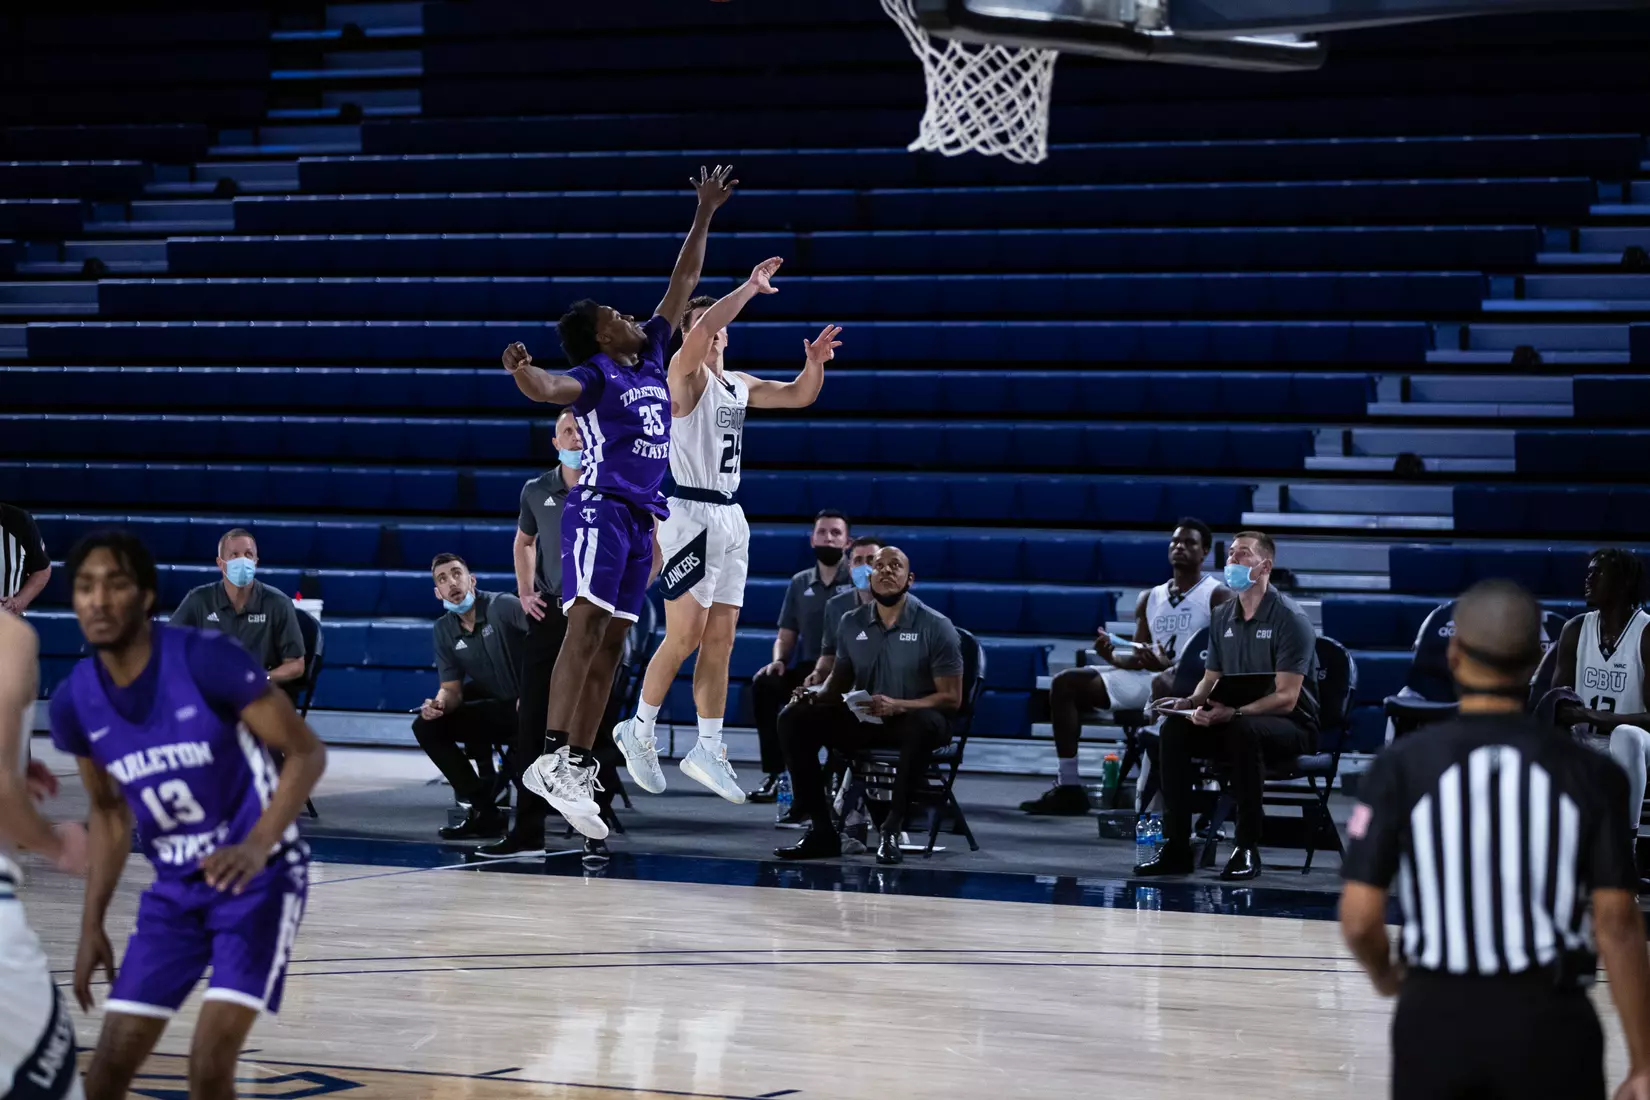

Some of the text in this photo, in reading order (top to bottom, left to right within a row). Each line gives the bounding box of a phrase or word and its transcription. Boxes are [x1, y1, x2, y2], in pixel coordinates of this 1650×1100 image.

[638, 403, 665, 437] 35
[632, 438, 669, 460] STATE
[664, 552, 701, 590] LANCERS
[247, 613, 266, 623] CBU
[1154, 614, 1191, 633] CBU
[899, 632, 918, 642] CBU
[1255, 629, 1273, 639] CBU
[1584, 666, 1627, 692] CBU
[140, 778, 206, 831] 13
